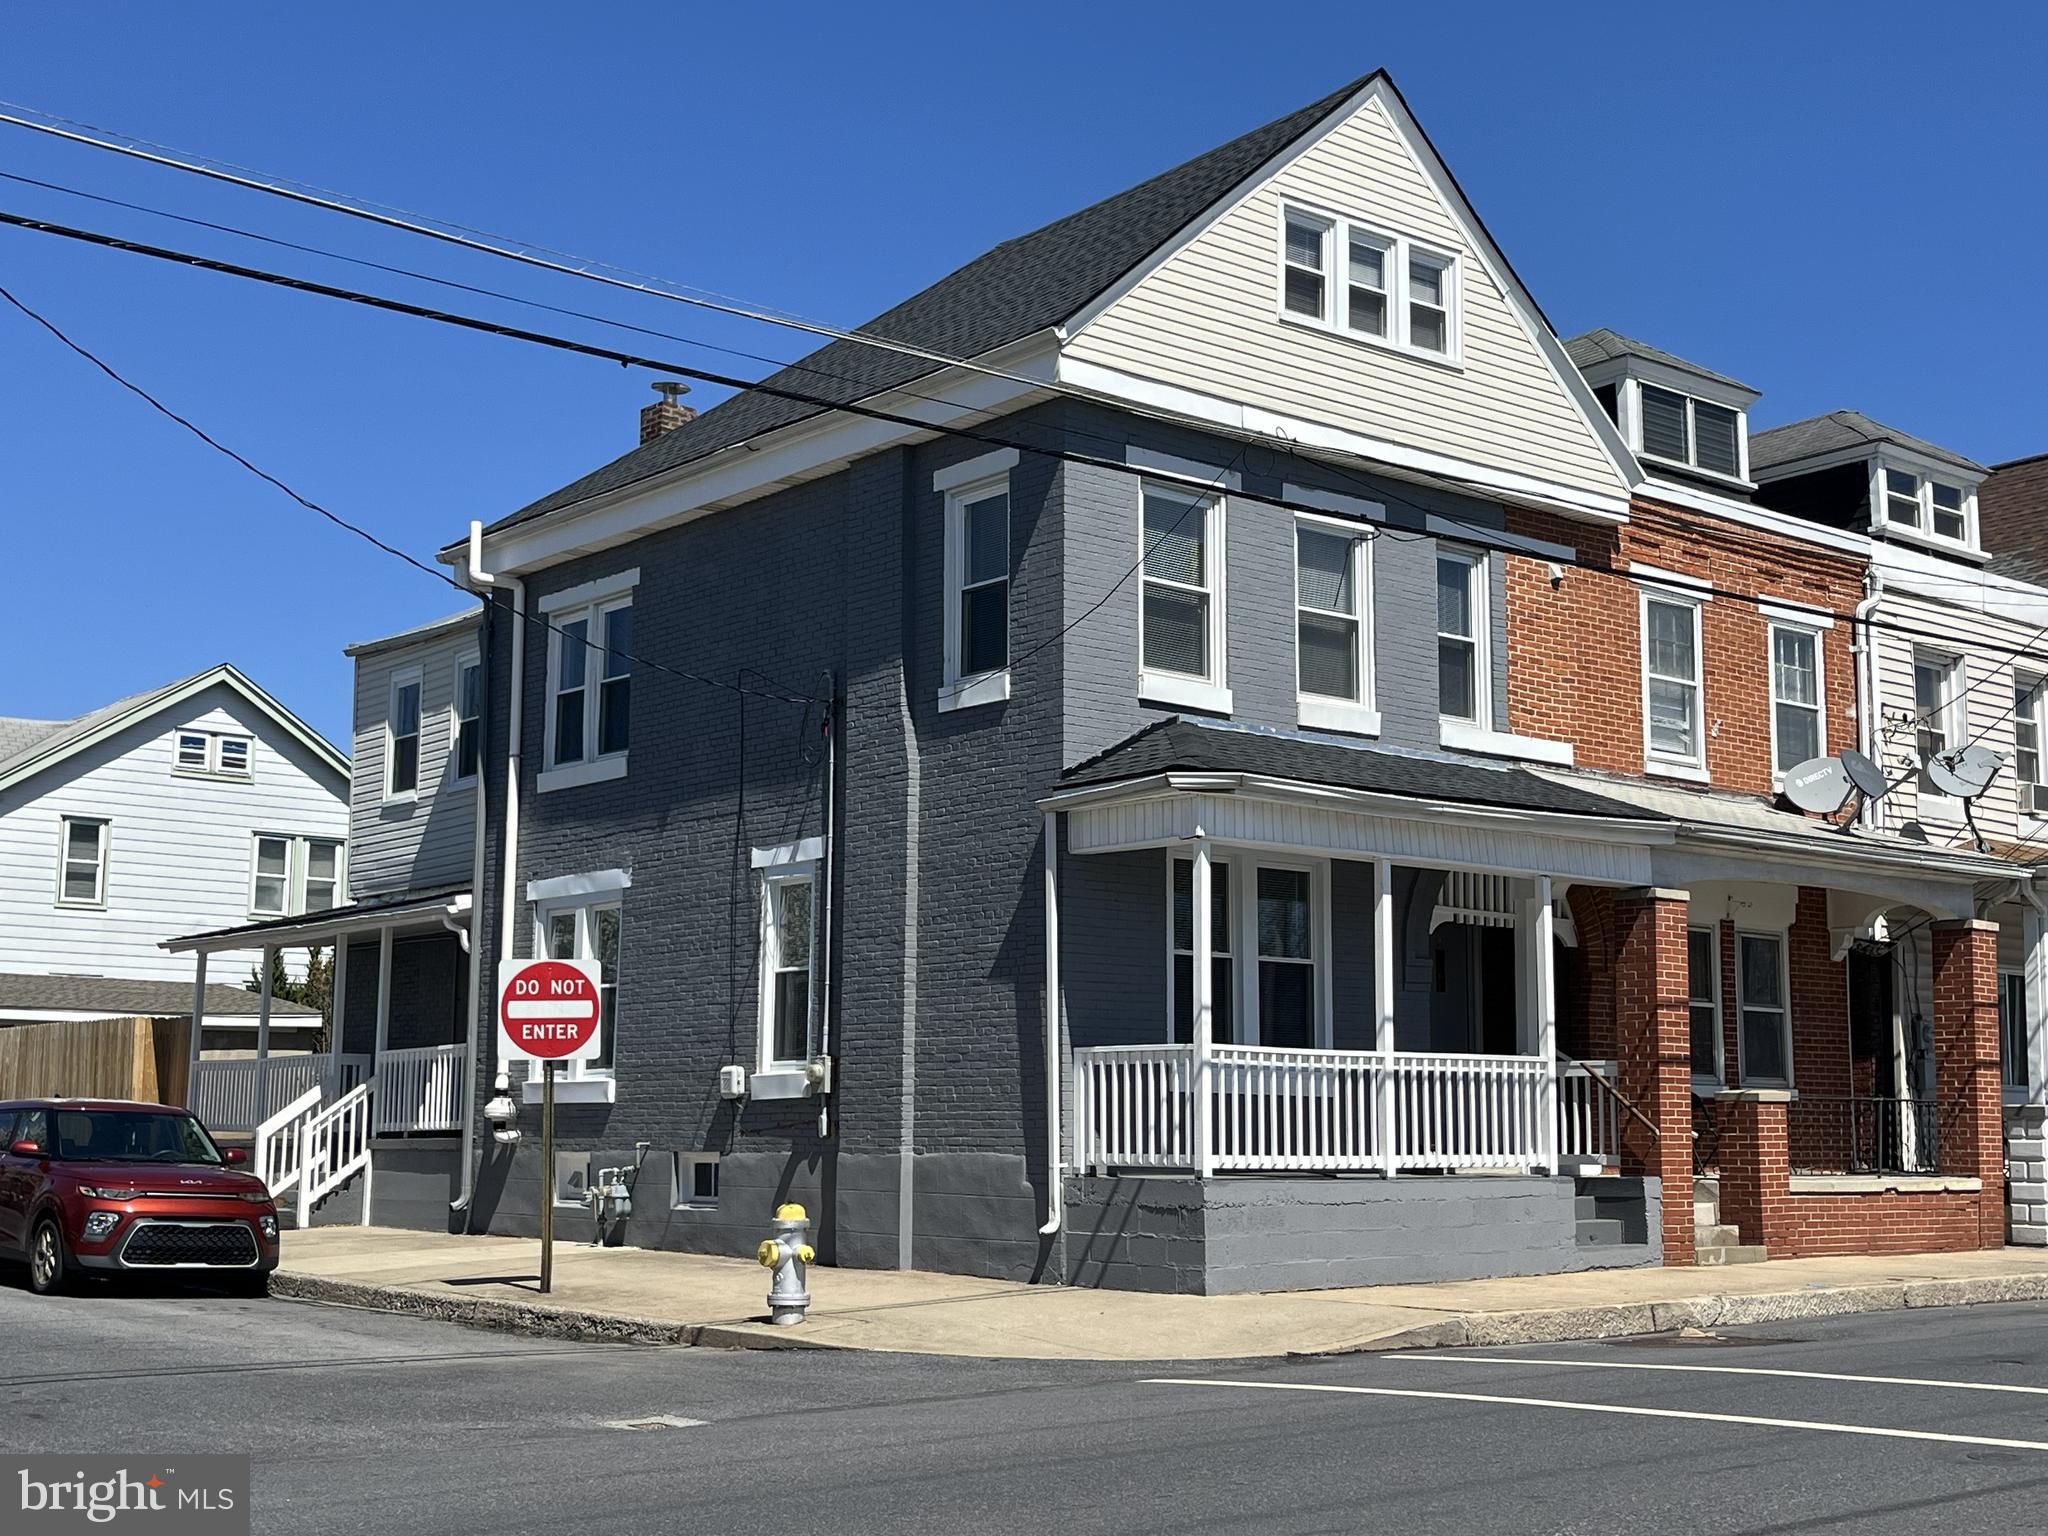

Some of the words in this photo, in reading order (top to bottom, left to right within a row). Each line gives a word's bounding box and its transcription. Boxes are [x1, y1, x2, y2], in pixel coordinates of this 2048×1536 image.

[1803, 766, 1832, 784] DIRECTV
[516, 980, 539, 995] DO
[551, 980, 585, 995] NOT
[522, 1024, 578, 1040] ENTER
